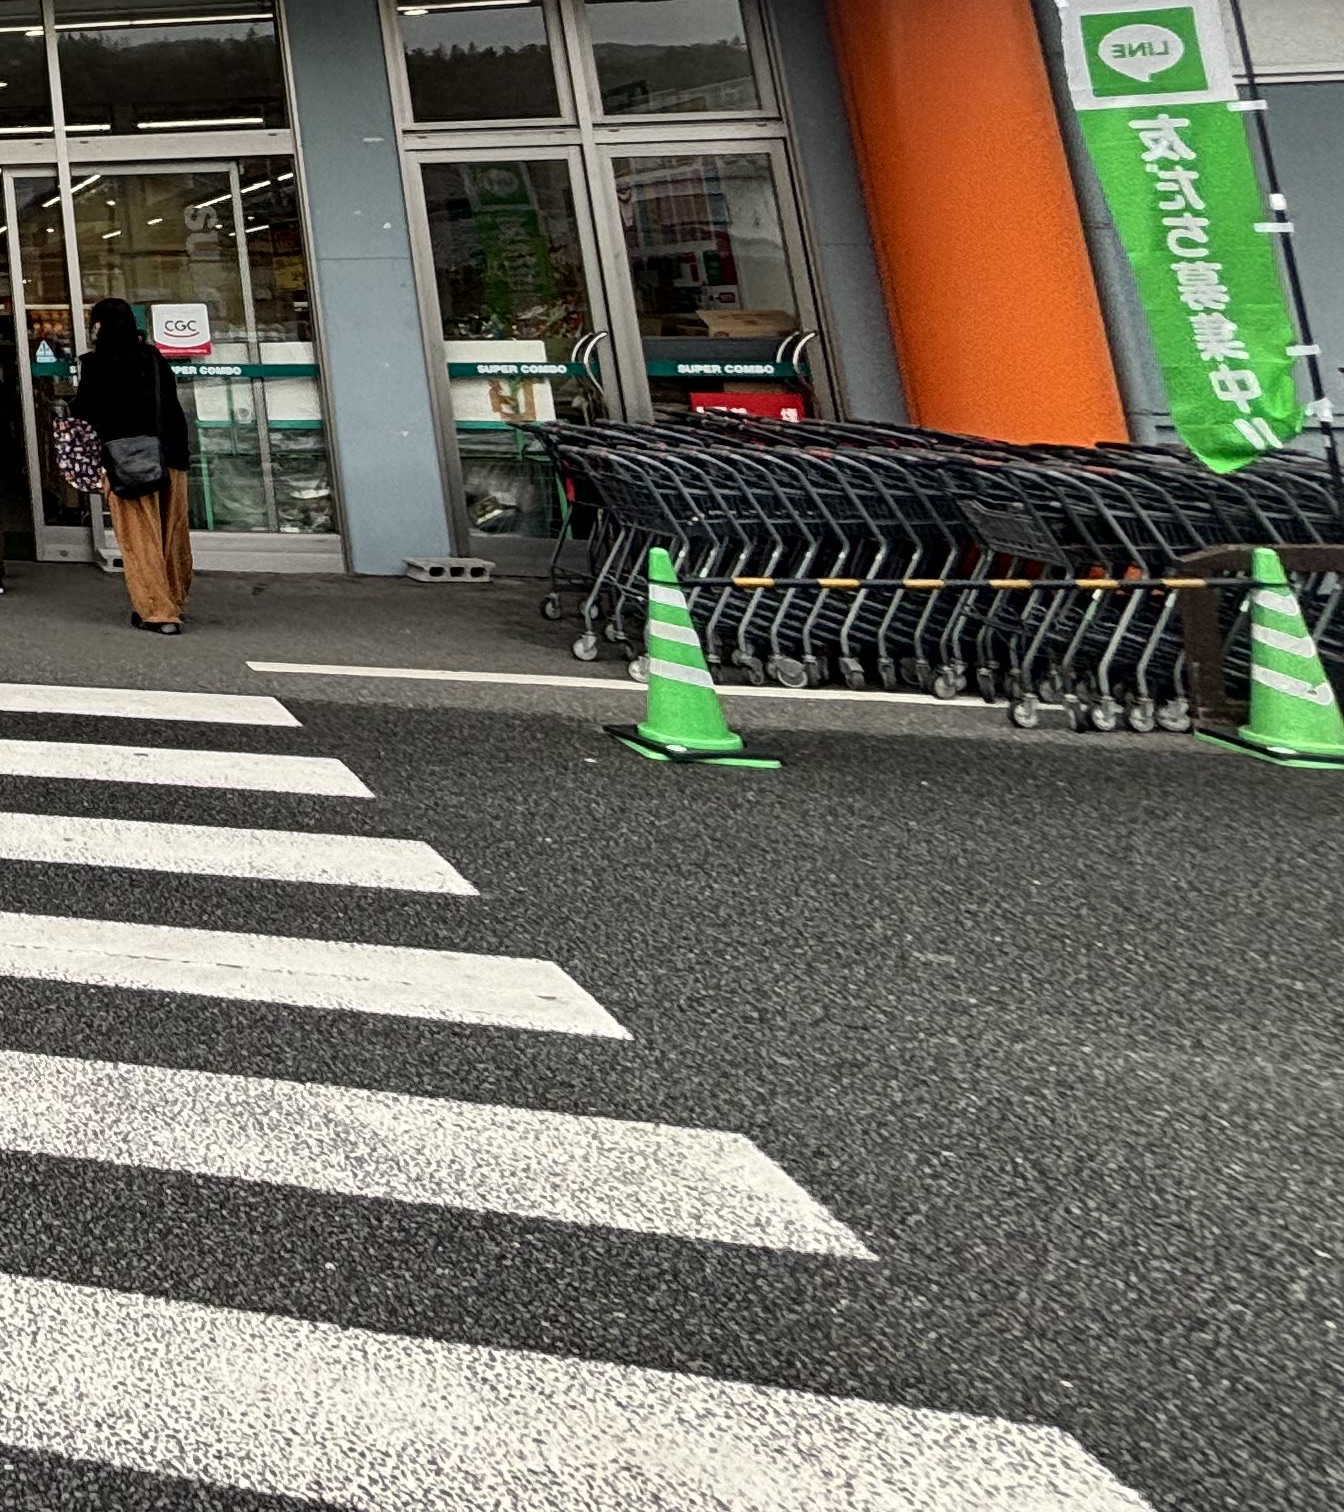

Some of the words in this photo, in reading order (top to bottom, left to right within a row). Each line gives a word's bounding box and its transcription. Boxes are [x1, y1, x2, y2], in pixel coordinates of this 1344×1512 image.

[164, 319, 198, 332] CGC
[199, 365, 242, 376] COMBO
[476, 364, 518, 375] SUPER
[520, 364, 568, 375] COMBO
[676, 364, 722, 375] SUPER
[723, 364, 775, 375] COMBO
